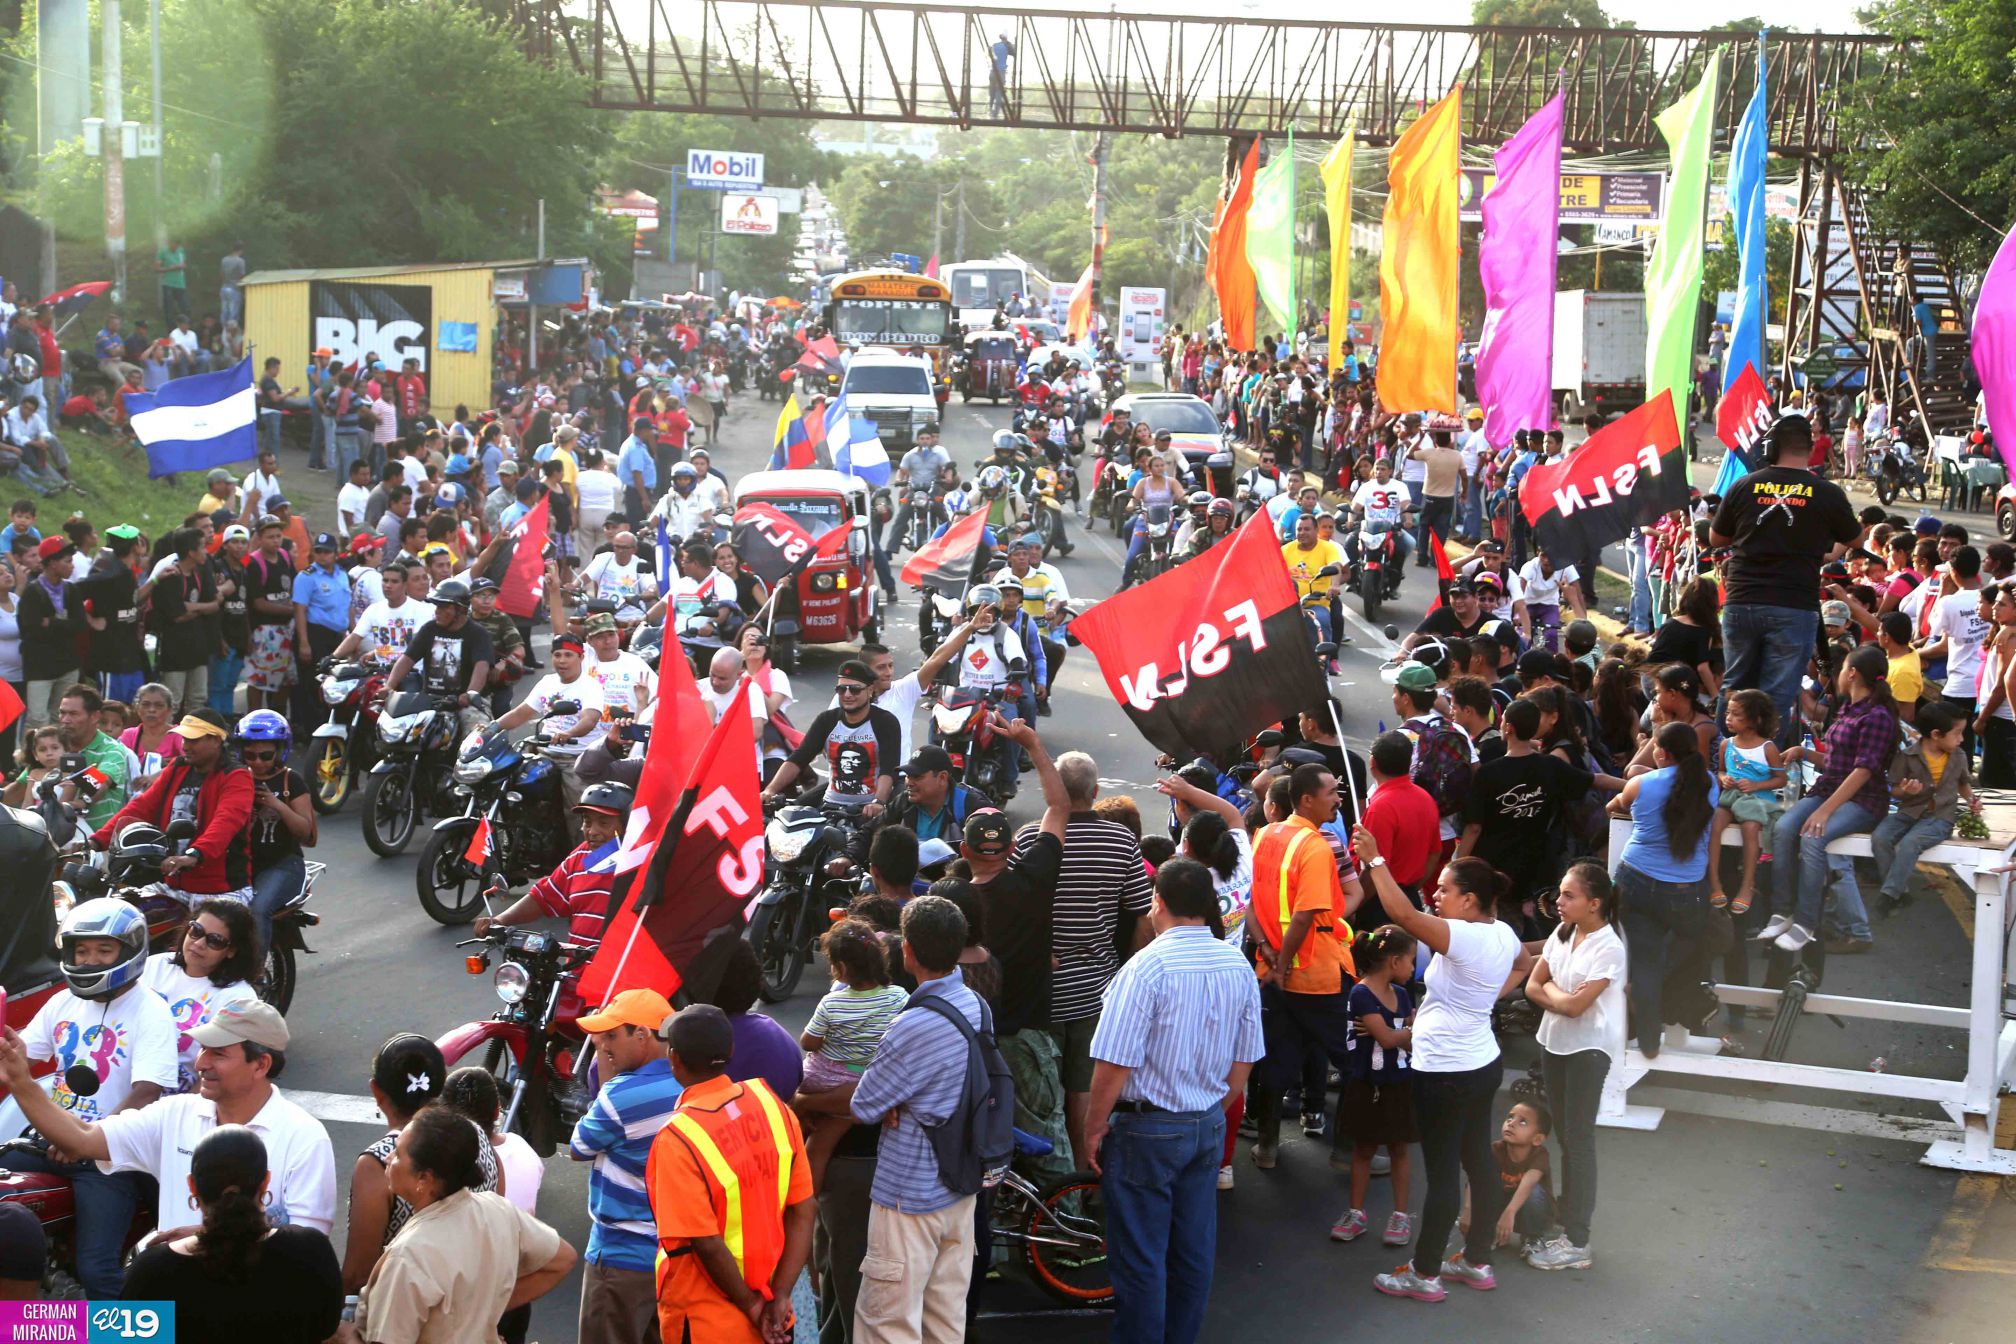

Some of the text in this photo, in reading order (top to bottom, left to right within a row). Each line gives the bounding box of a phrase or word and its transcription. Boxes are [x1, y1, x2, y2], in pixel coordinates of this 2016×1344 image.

[692, 154, 756, 177] Mobil
[1562, 177, 1583, 188] DE
[842, 300, 940, 309] POPEYE
[316, 317, 425, 373] BIG
[880, 333, 941, 344] PEDRO
[371, 626, 413, 646] FSLN
